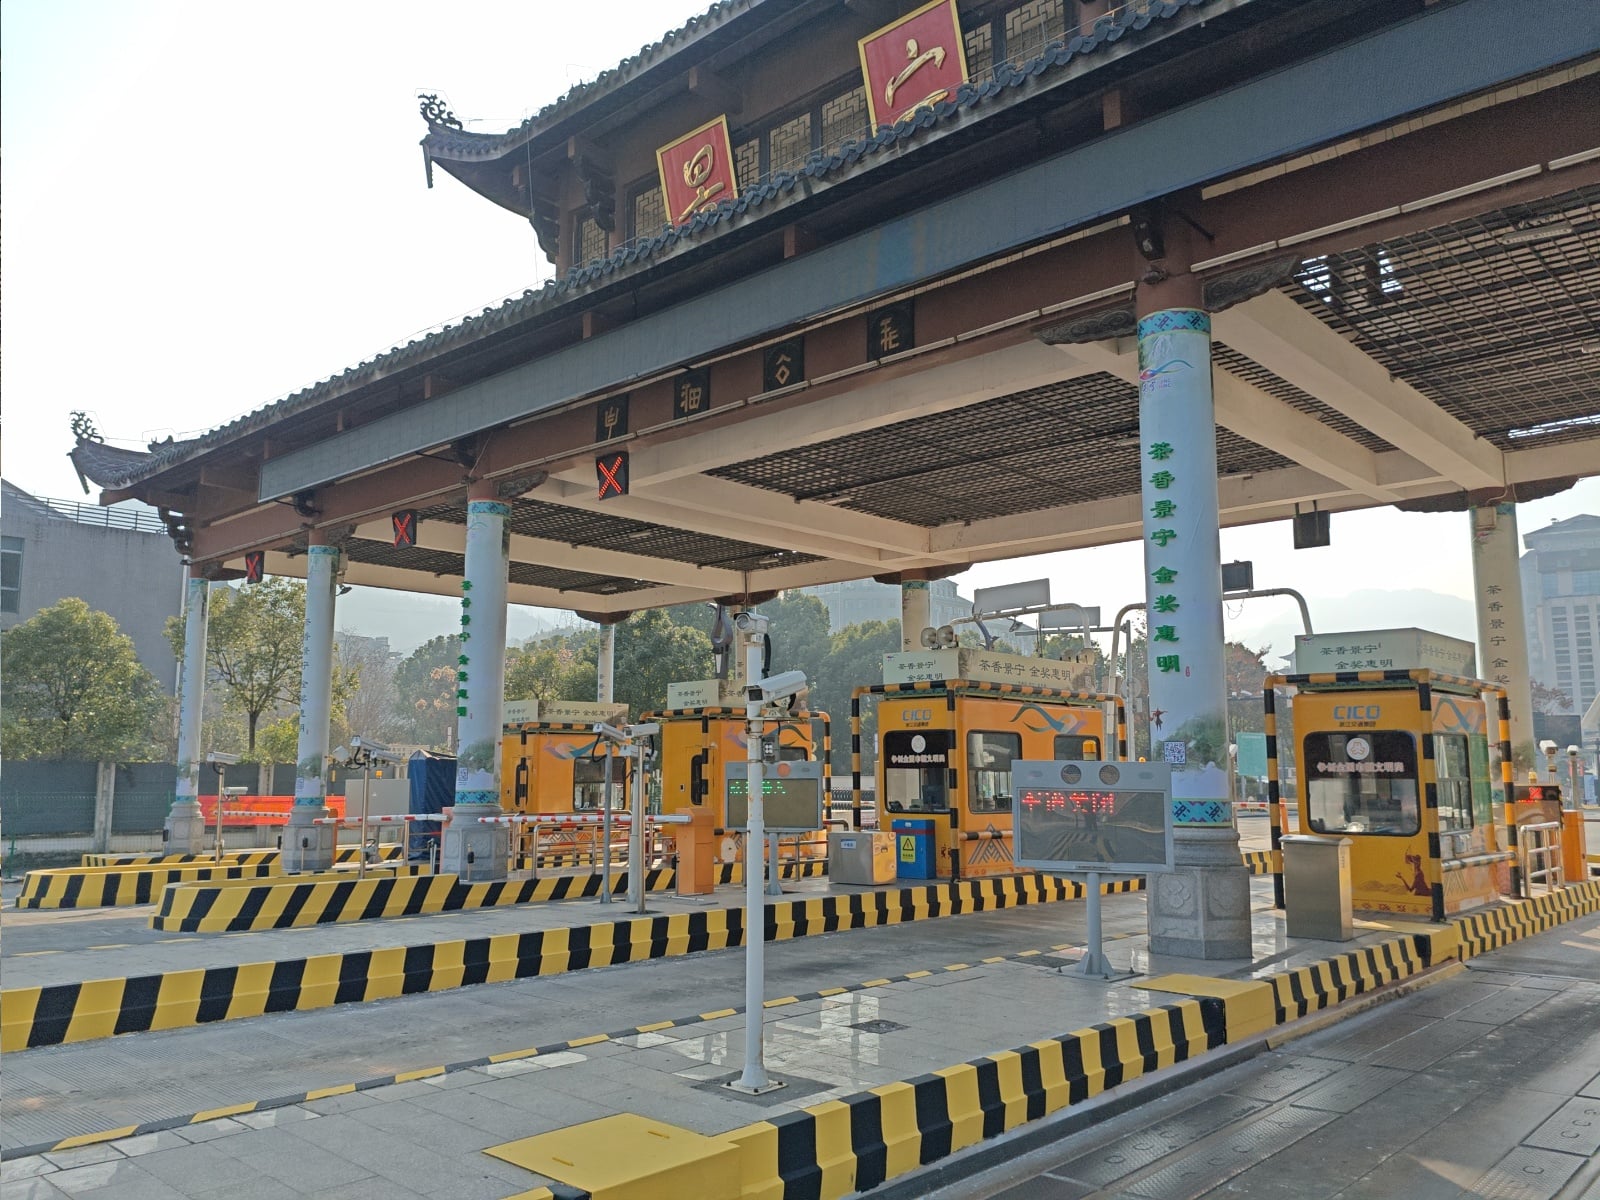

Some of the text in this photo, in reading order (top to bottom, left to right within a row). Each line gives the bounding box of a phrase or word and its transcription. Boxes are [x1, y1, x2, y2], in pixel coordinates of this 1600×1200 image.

[1147, 441, 1181, 673] 茶香景宁 金奖惠明
[1486, 585, 1506, 647] 茶香景宁
[1319, 644, 1378, 656] 茶香景宁
[979, 659, 1072, 681] 茶香景宁 金奖惠明
[1335, 658, 1393, 670] 金奖惠明
[902, 709, 932, 721] CICO
[1334, 705, 1380, 720] CICO
